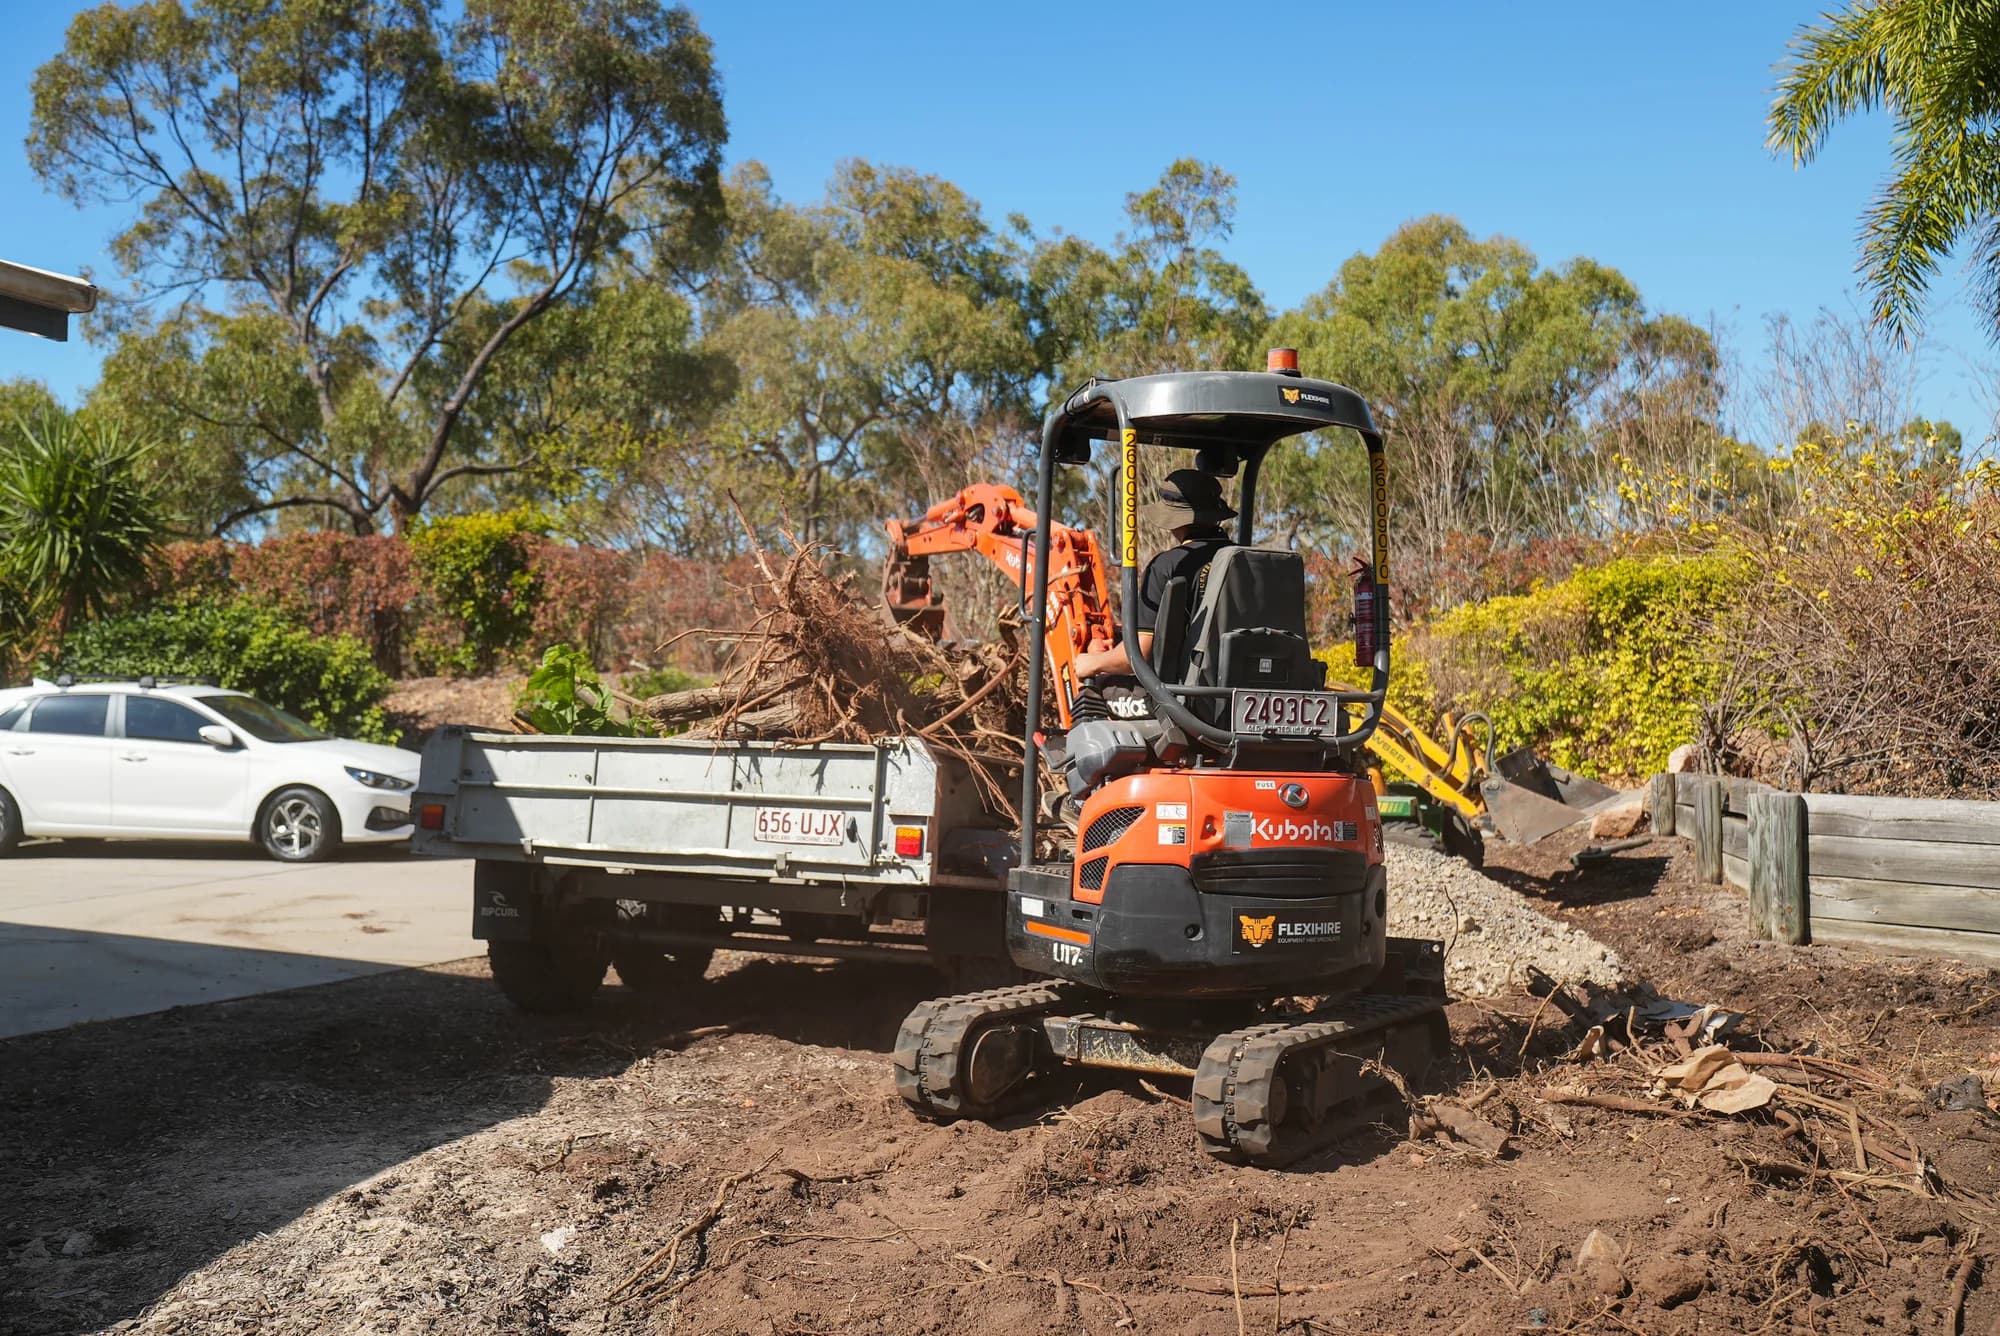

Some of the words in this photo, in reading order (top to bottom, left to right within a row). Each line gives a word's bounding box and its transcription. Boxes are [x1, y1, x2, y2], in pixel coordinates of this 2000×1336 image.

[1126, 432, 1137, 561] 26009070
[1375, 458, 1388, 579] 26009070
[1243, 695, 1330, 726] 2493C2
[1250, 818, 1332, 841] Kubota
[1278, 921, 1341, 936] FLEXIHIRE
